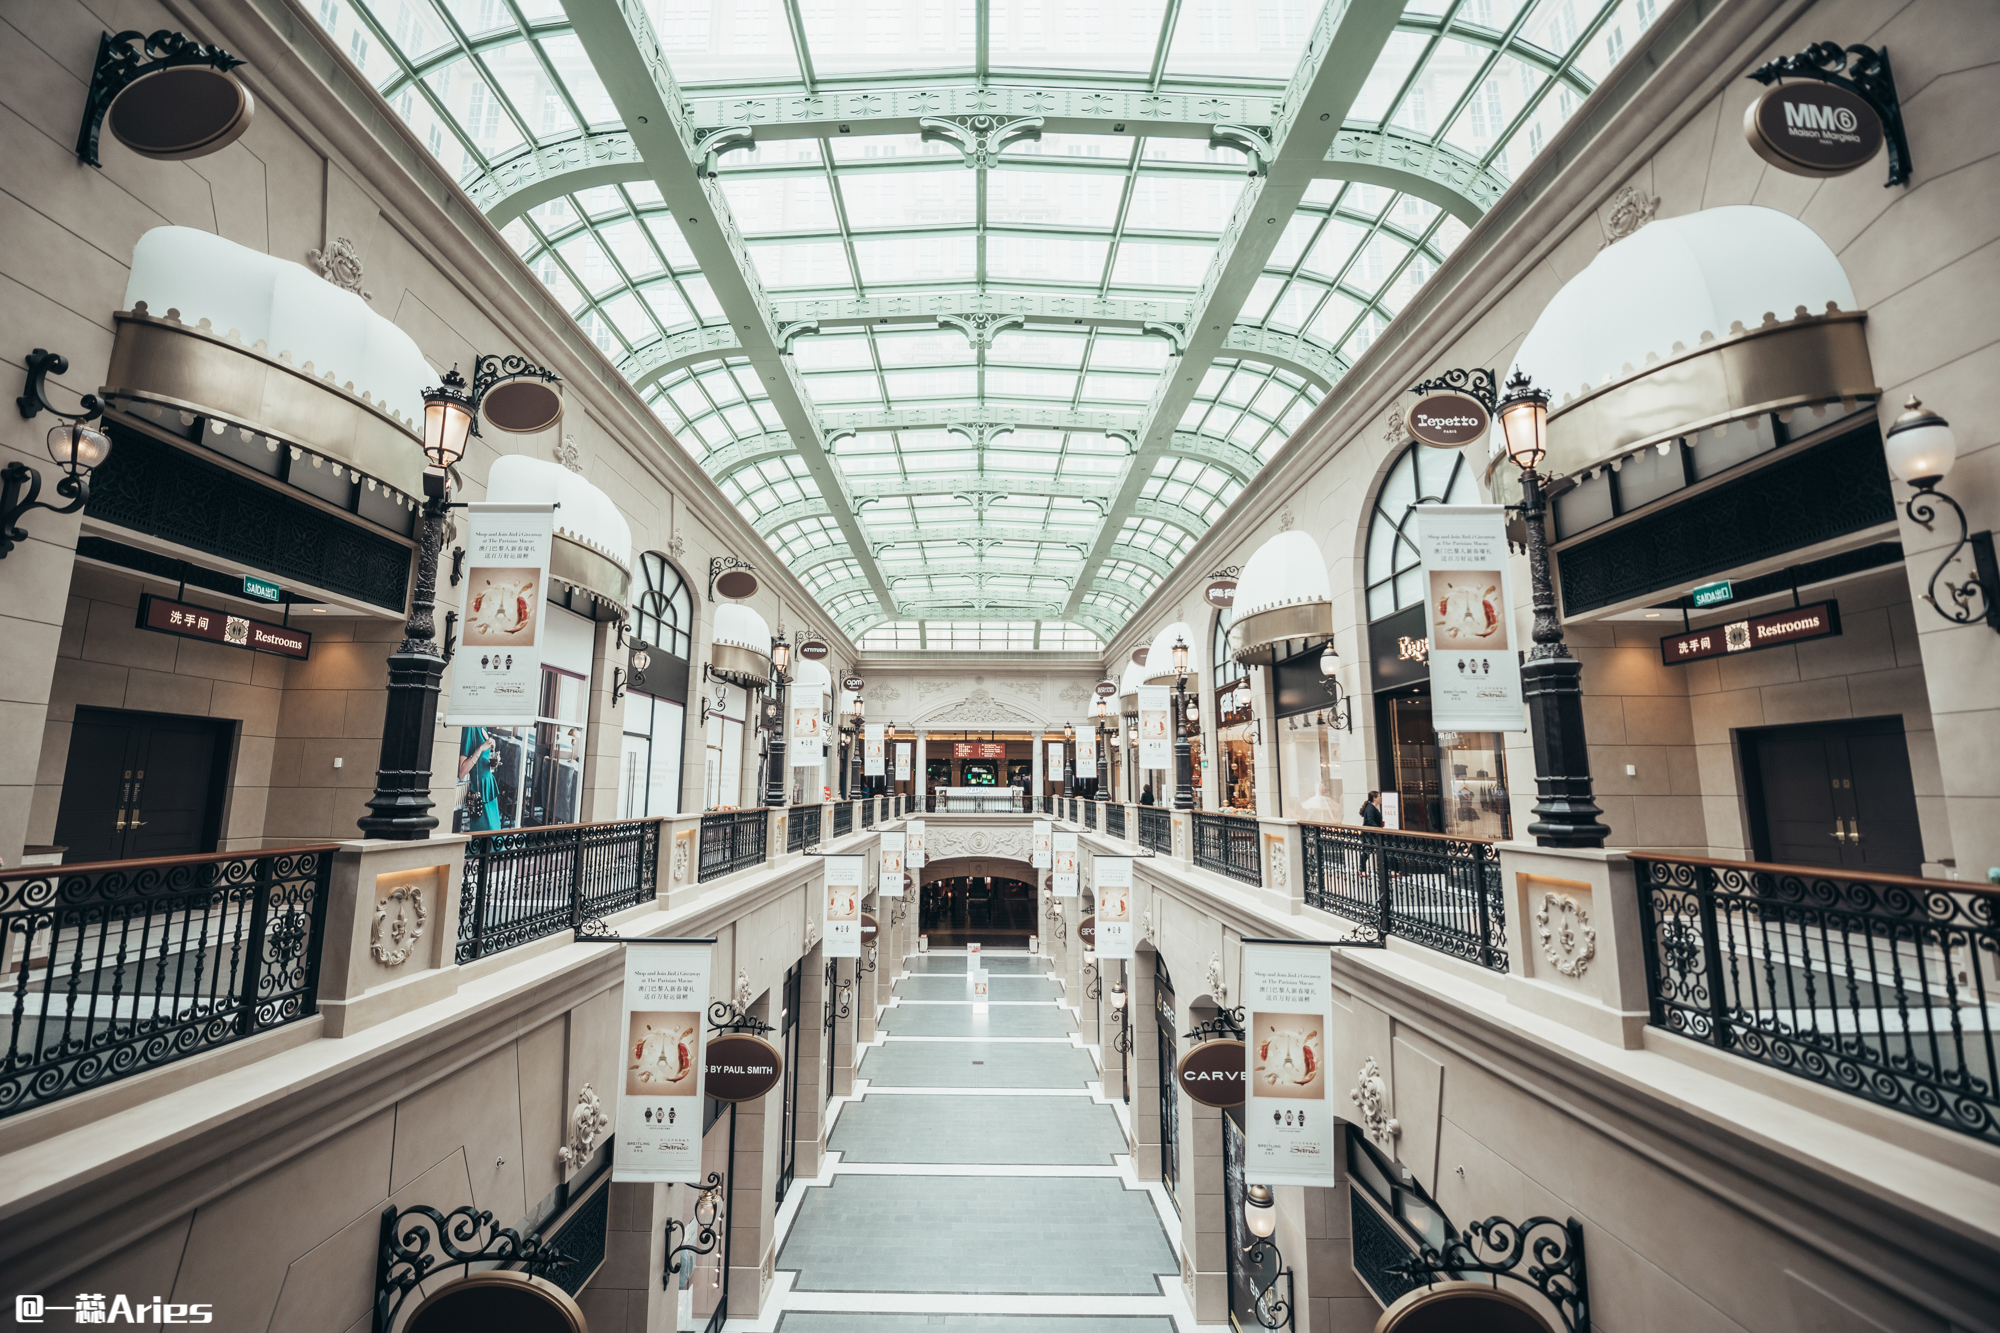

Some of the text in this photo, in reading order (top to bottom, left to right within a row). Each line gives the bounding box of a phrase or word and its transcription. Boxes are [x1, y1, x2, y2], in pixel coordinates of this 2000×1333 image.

[1788, 127, 1861, 143] Maison Margiela
[1417, 414, 1478, 429] repetto
[169, 610, 210, 631] 洗手间
[1757, 616, 1820, 638] Restrooms
[255, 629, 303, 650] Restrooms
[1678, 636, 1711, 655] 洗手间
[846, 679, 862, 687] apm
[710, 1065, 722, 1073] BY
[723, 1065, 745, 1074] PAUL
[747, 1066, 773, 1075] SMITH
